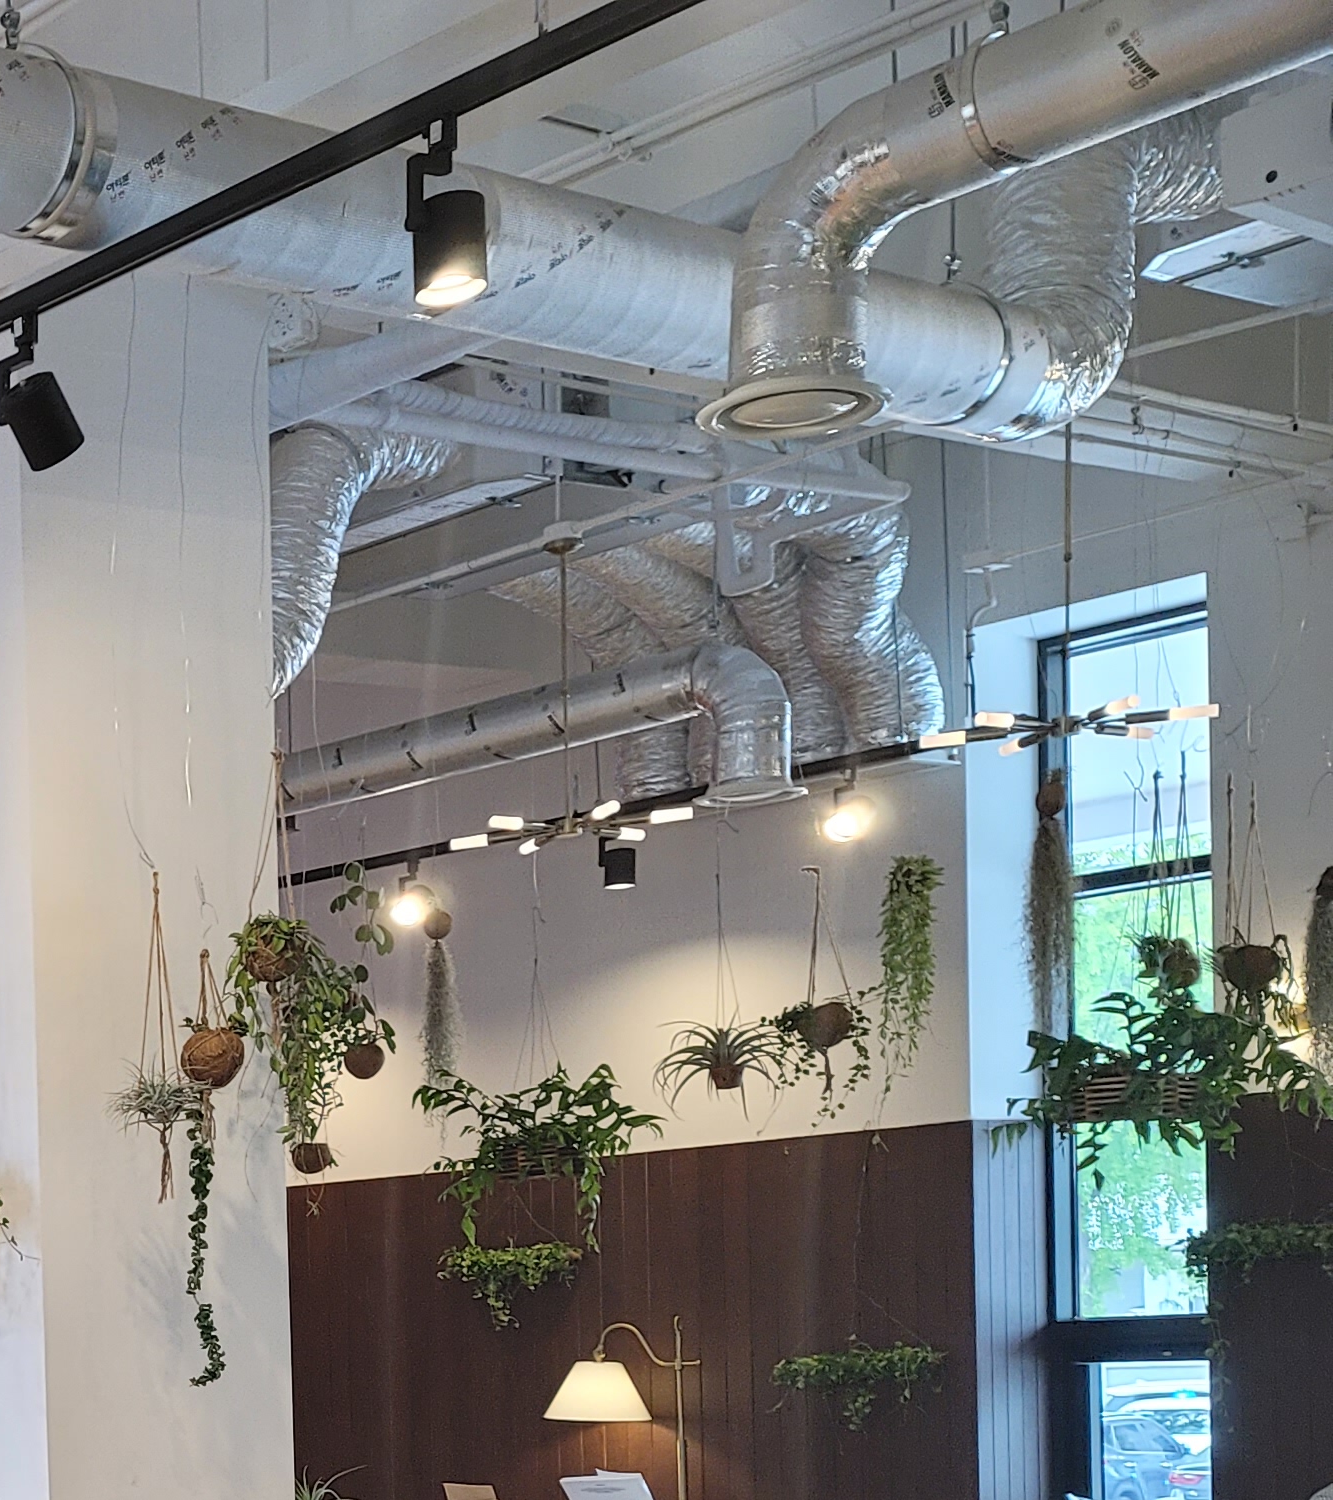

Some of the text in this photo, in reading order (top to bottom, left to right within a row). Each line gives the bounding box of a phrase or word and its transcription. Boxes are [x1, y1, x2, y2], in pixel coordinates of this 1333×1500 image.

[1117, 38, 1161, 81] HANALON
[144, 149, 166, 171] 아티론
[106, 170, 132, 193] 아티론
